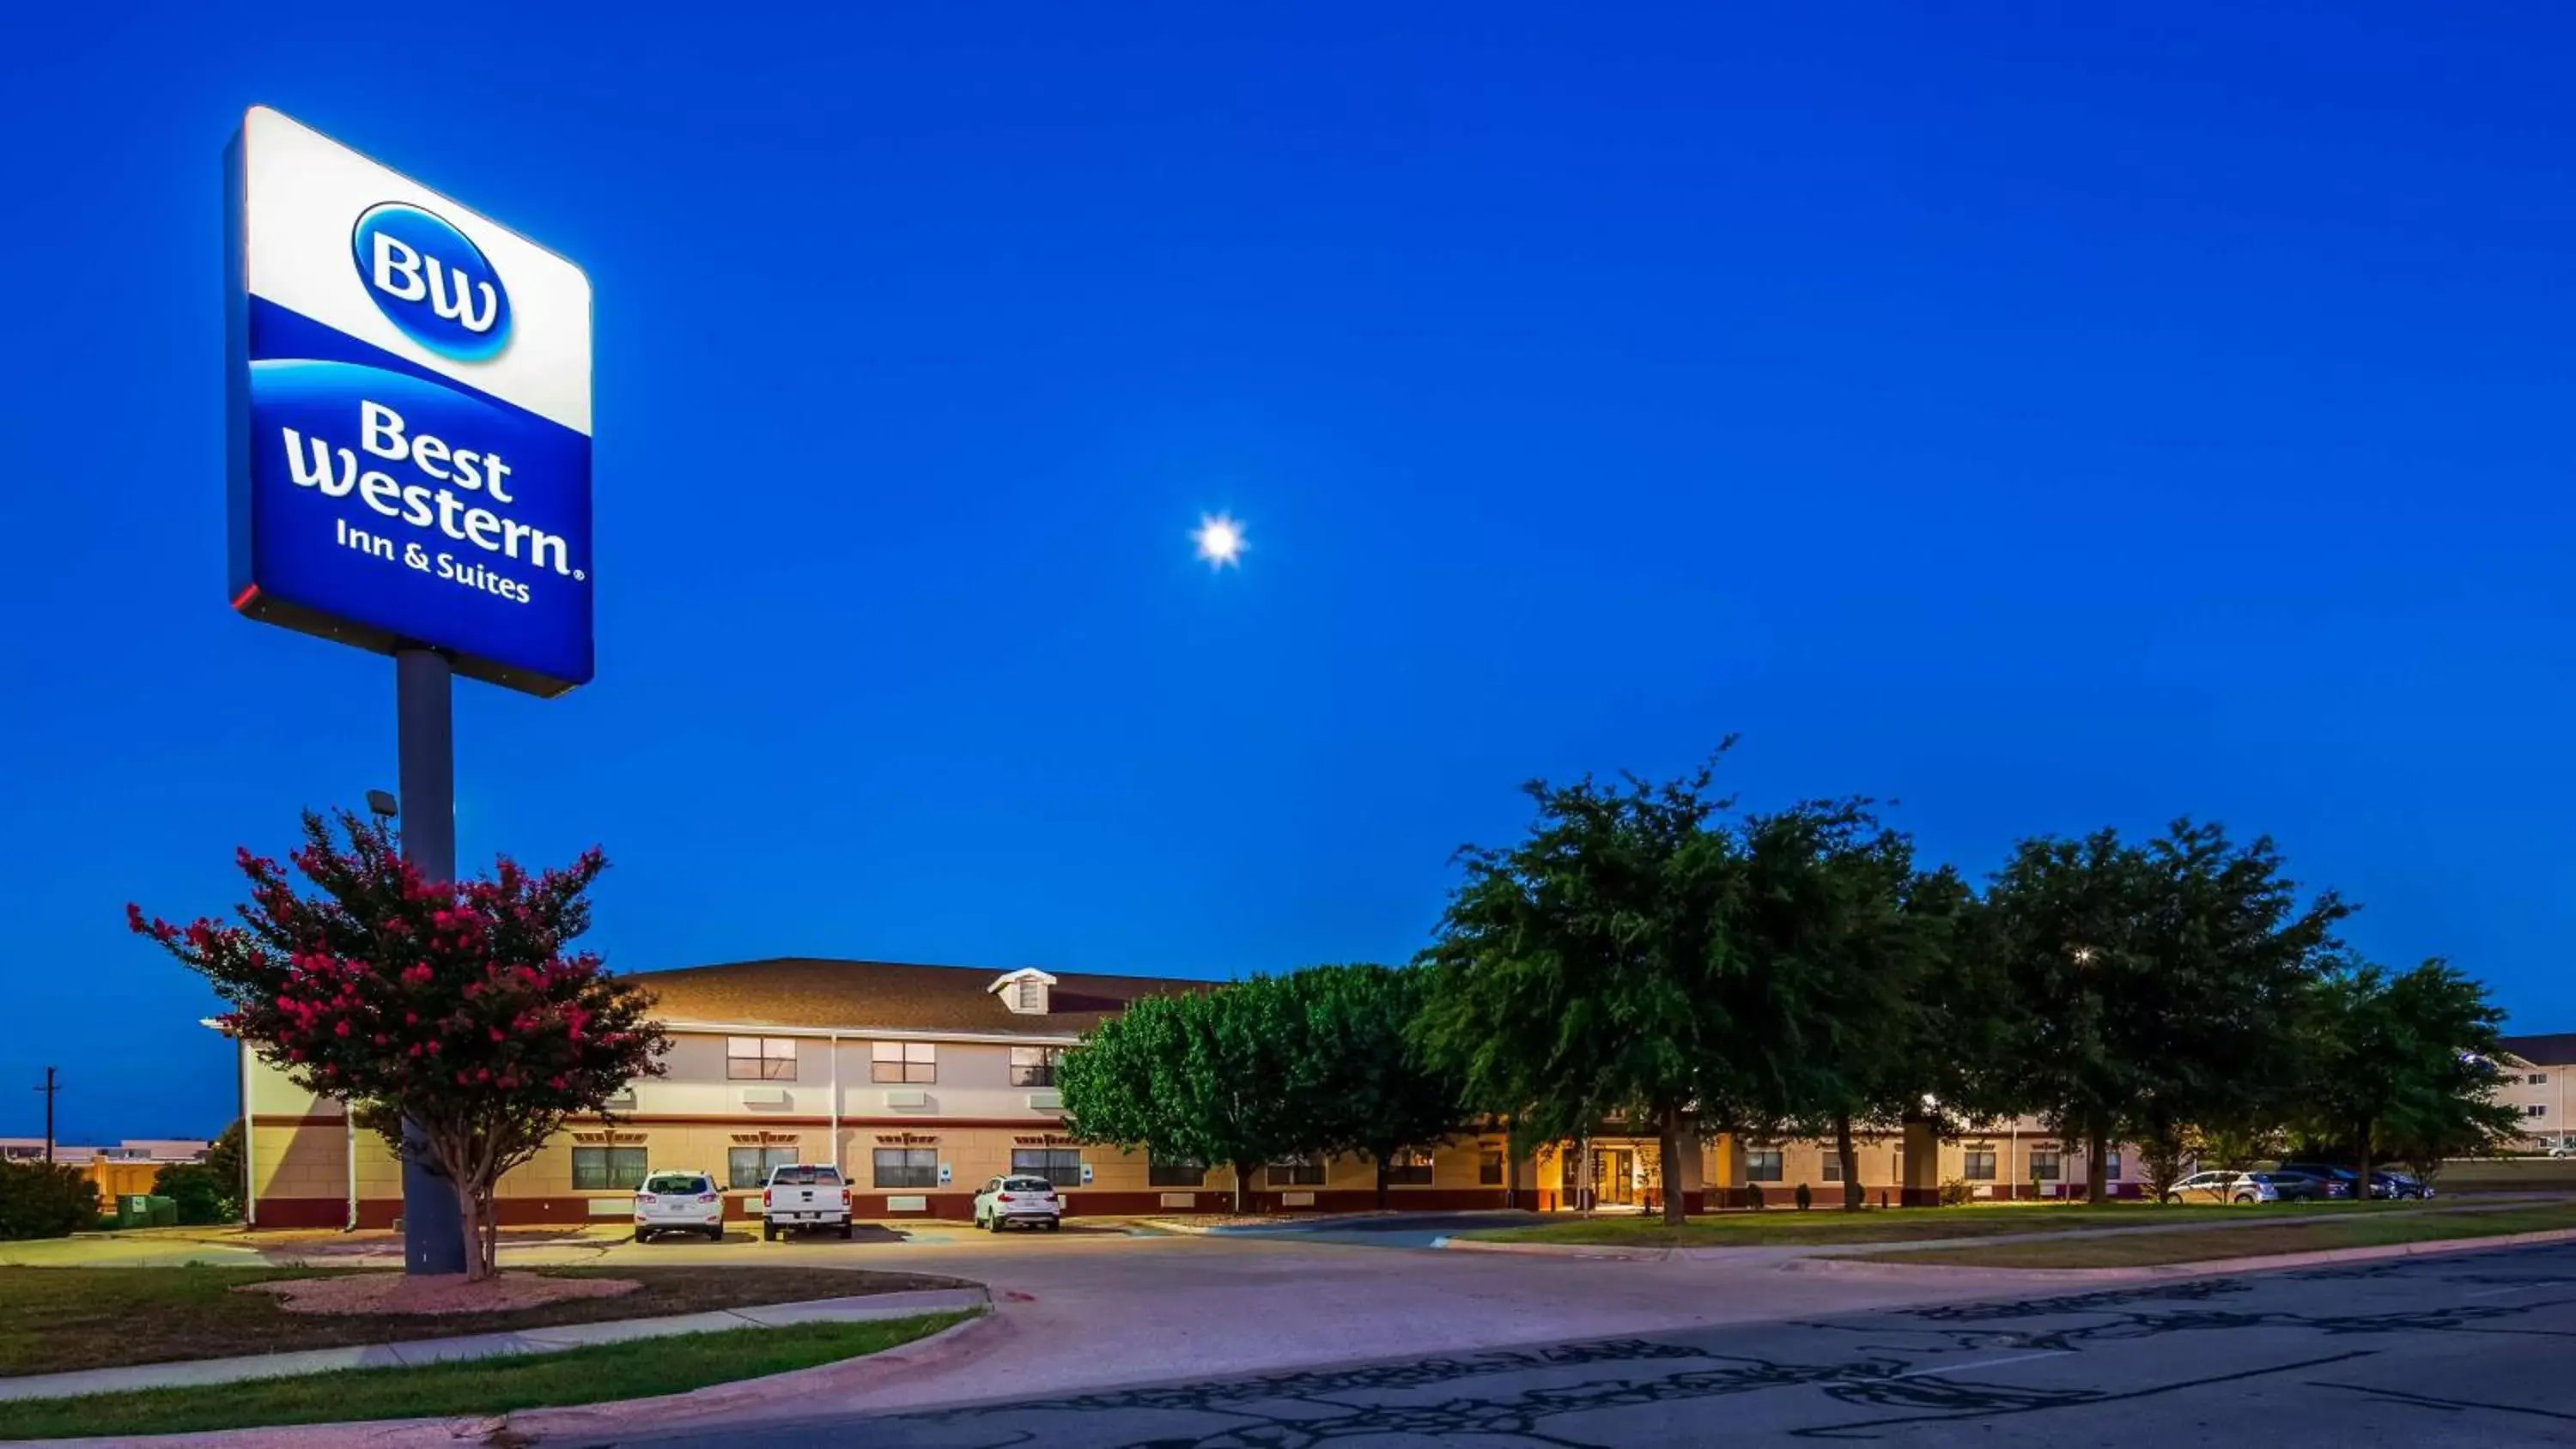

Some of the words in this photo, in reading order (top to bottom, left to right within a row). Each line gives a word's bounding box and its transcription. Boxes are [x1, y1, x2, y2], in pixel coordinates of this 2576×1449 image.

[373, 231, 497, 332] BW
[362, 399, 512, 503] Best
[337, 518, 395, 561] Inn
[404, 543, 431, 573] &
[437, 553, 530, 603] Suites
